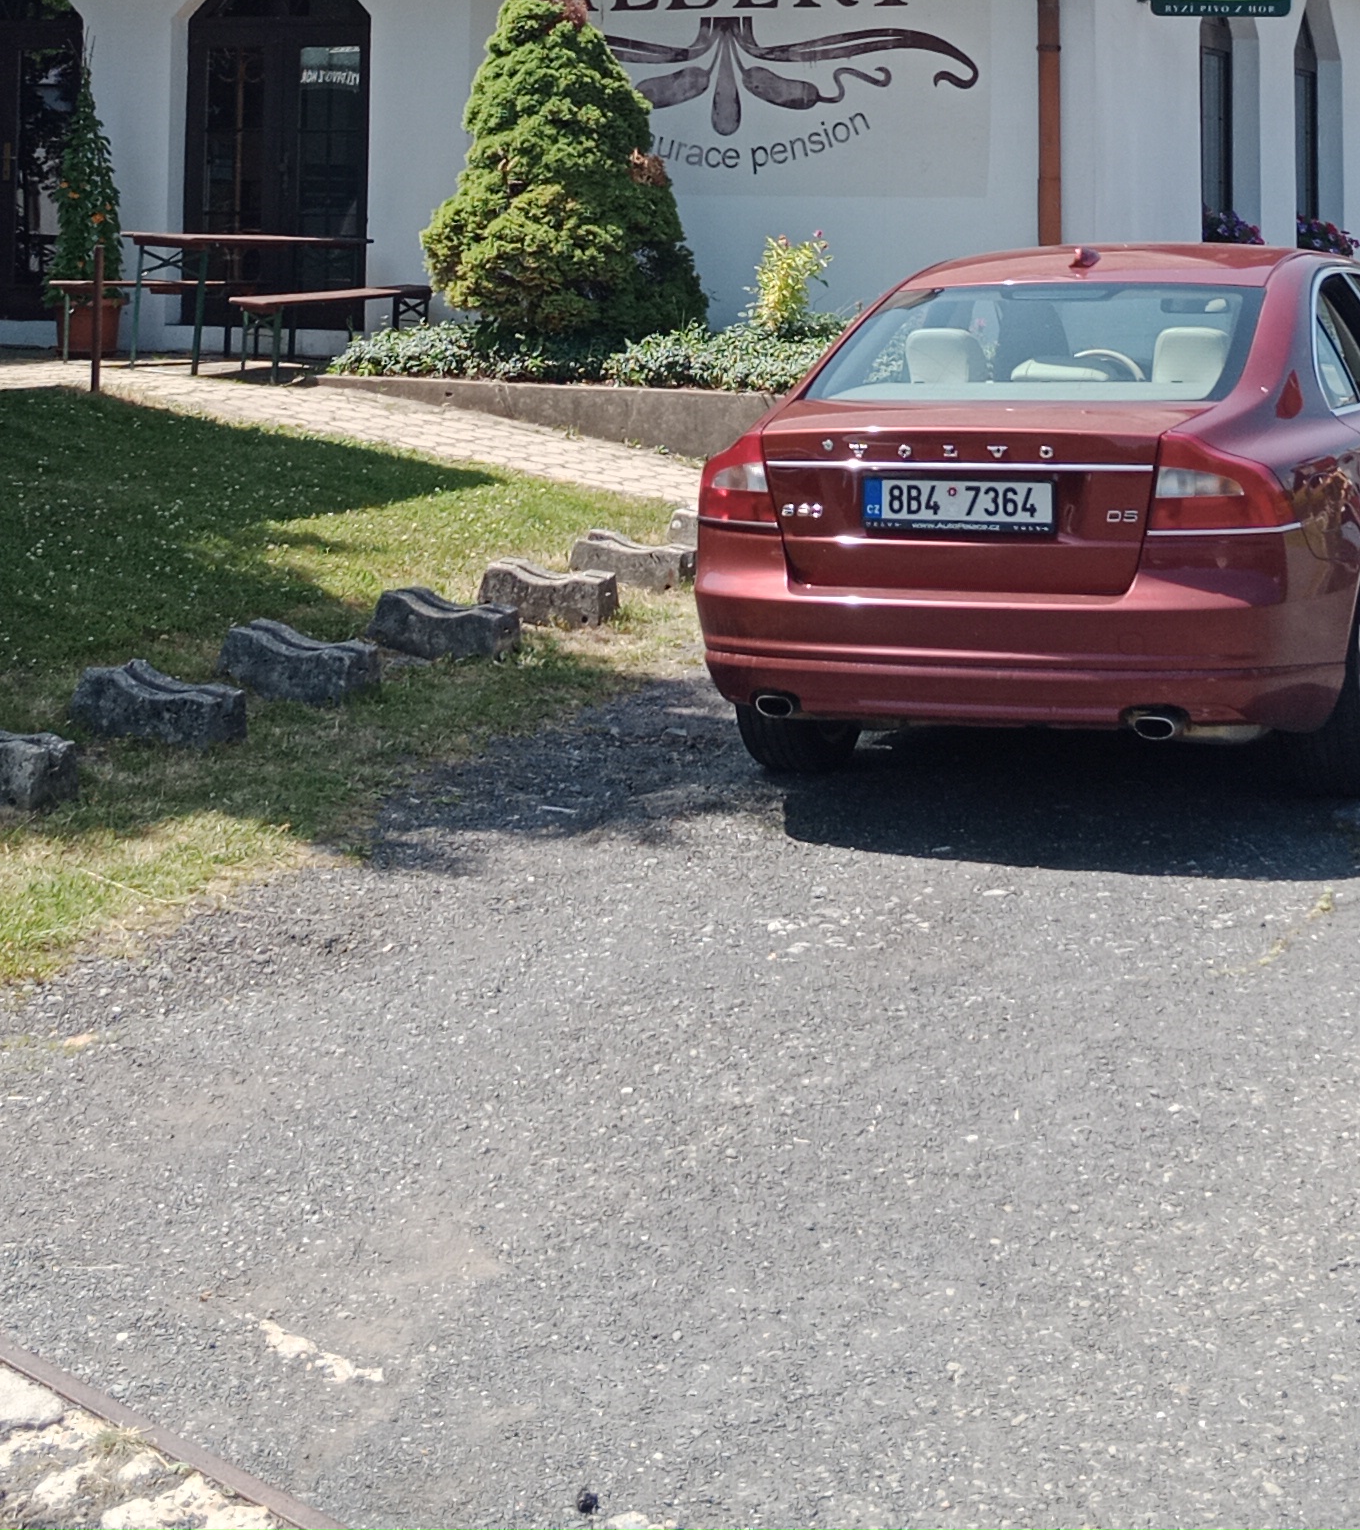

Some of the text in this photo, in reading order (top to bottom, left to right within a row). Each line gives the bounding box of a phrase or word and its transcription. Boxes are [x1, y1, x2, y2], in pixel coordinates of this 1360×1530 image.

[1200, 5, 1230, 14] PIVO
[650, 111, 871, 175] urace pension
[866, 503, 881, 515] CZ
[888, 484, 1038, 518] 8B4 7364
